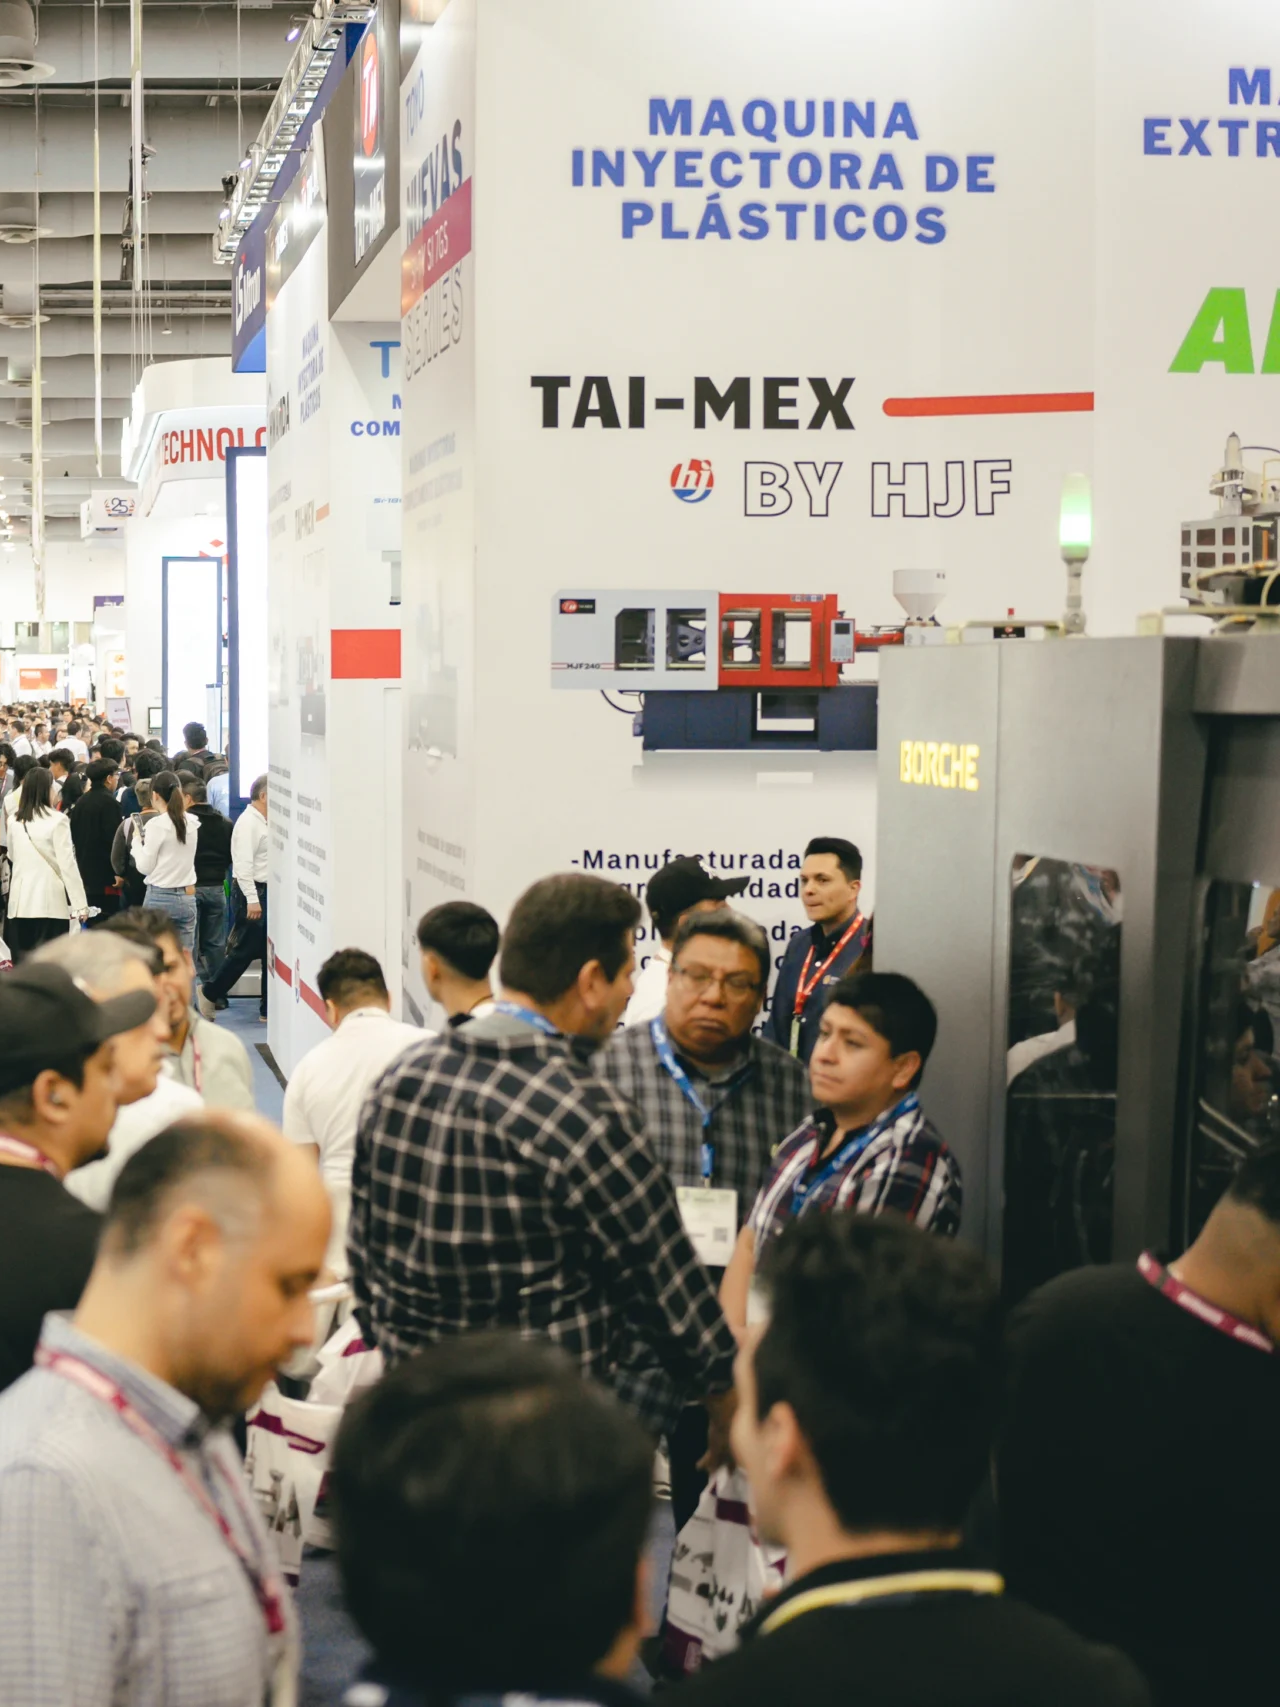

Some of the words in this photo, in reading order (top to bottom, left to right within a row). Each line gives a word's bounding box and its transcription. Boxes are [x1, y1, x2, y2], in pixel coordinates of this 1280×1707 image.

[1229, 67, 1280, 106] M
[648, 97, 919, 143] MAQUINA
[406, 118, 463, 246] NUEVAS
[571, 149, 905, 191] INYECTORA
[924, 155, 996, 194] DE
[621, 191, 948, 246] PLÁSTICOS
[1167, 286, 1280, 375] A
[530, 375, 856, 430] TAI-MEX
[743, 461, 844, 518] BY
[870, 459, 1013, 518] HJF
[566, 662, 601, 670] HJF240
[899, 739, 981, 793] BORCHE
[571, 848, 802, 870] -Manufturada
